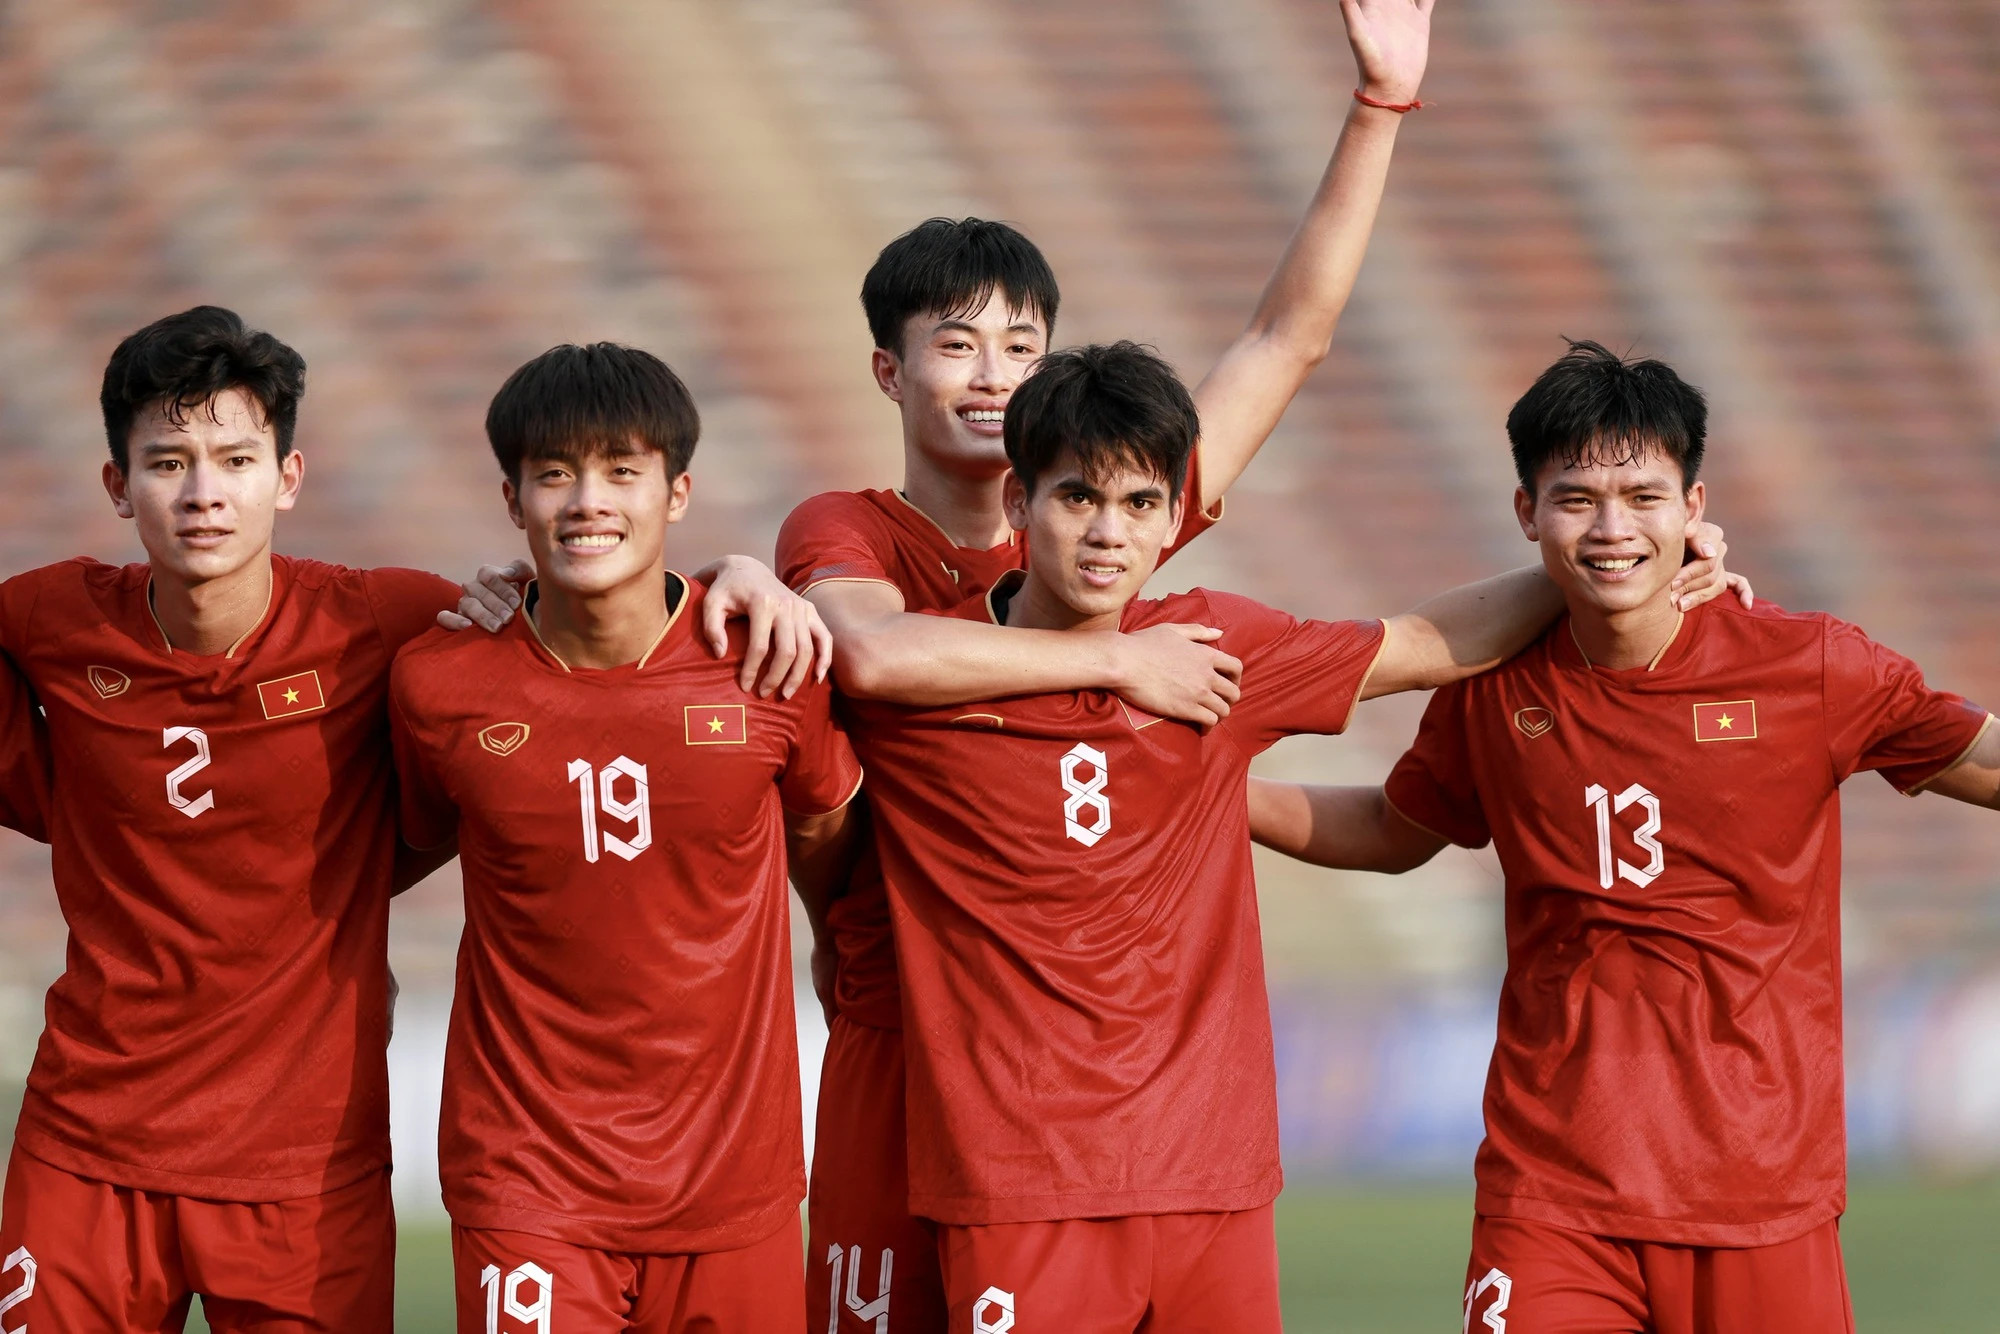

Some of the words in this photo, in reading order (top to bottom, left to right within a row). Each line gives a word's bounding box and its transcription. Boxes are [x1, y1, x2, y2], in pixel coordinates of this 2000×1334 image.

[163, 726, 214, 818] 2
[567, 755, 652, 863] 19
[1060, 742, 1111, 847] 8
[1585, 783, 1664, 889] 13
[0, 1245, 37, 1334] 2
[480, 1261, 553, 1334] 19
[827, 1243, 894, 1334] 14
